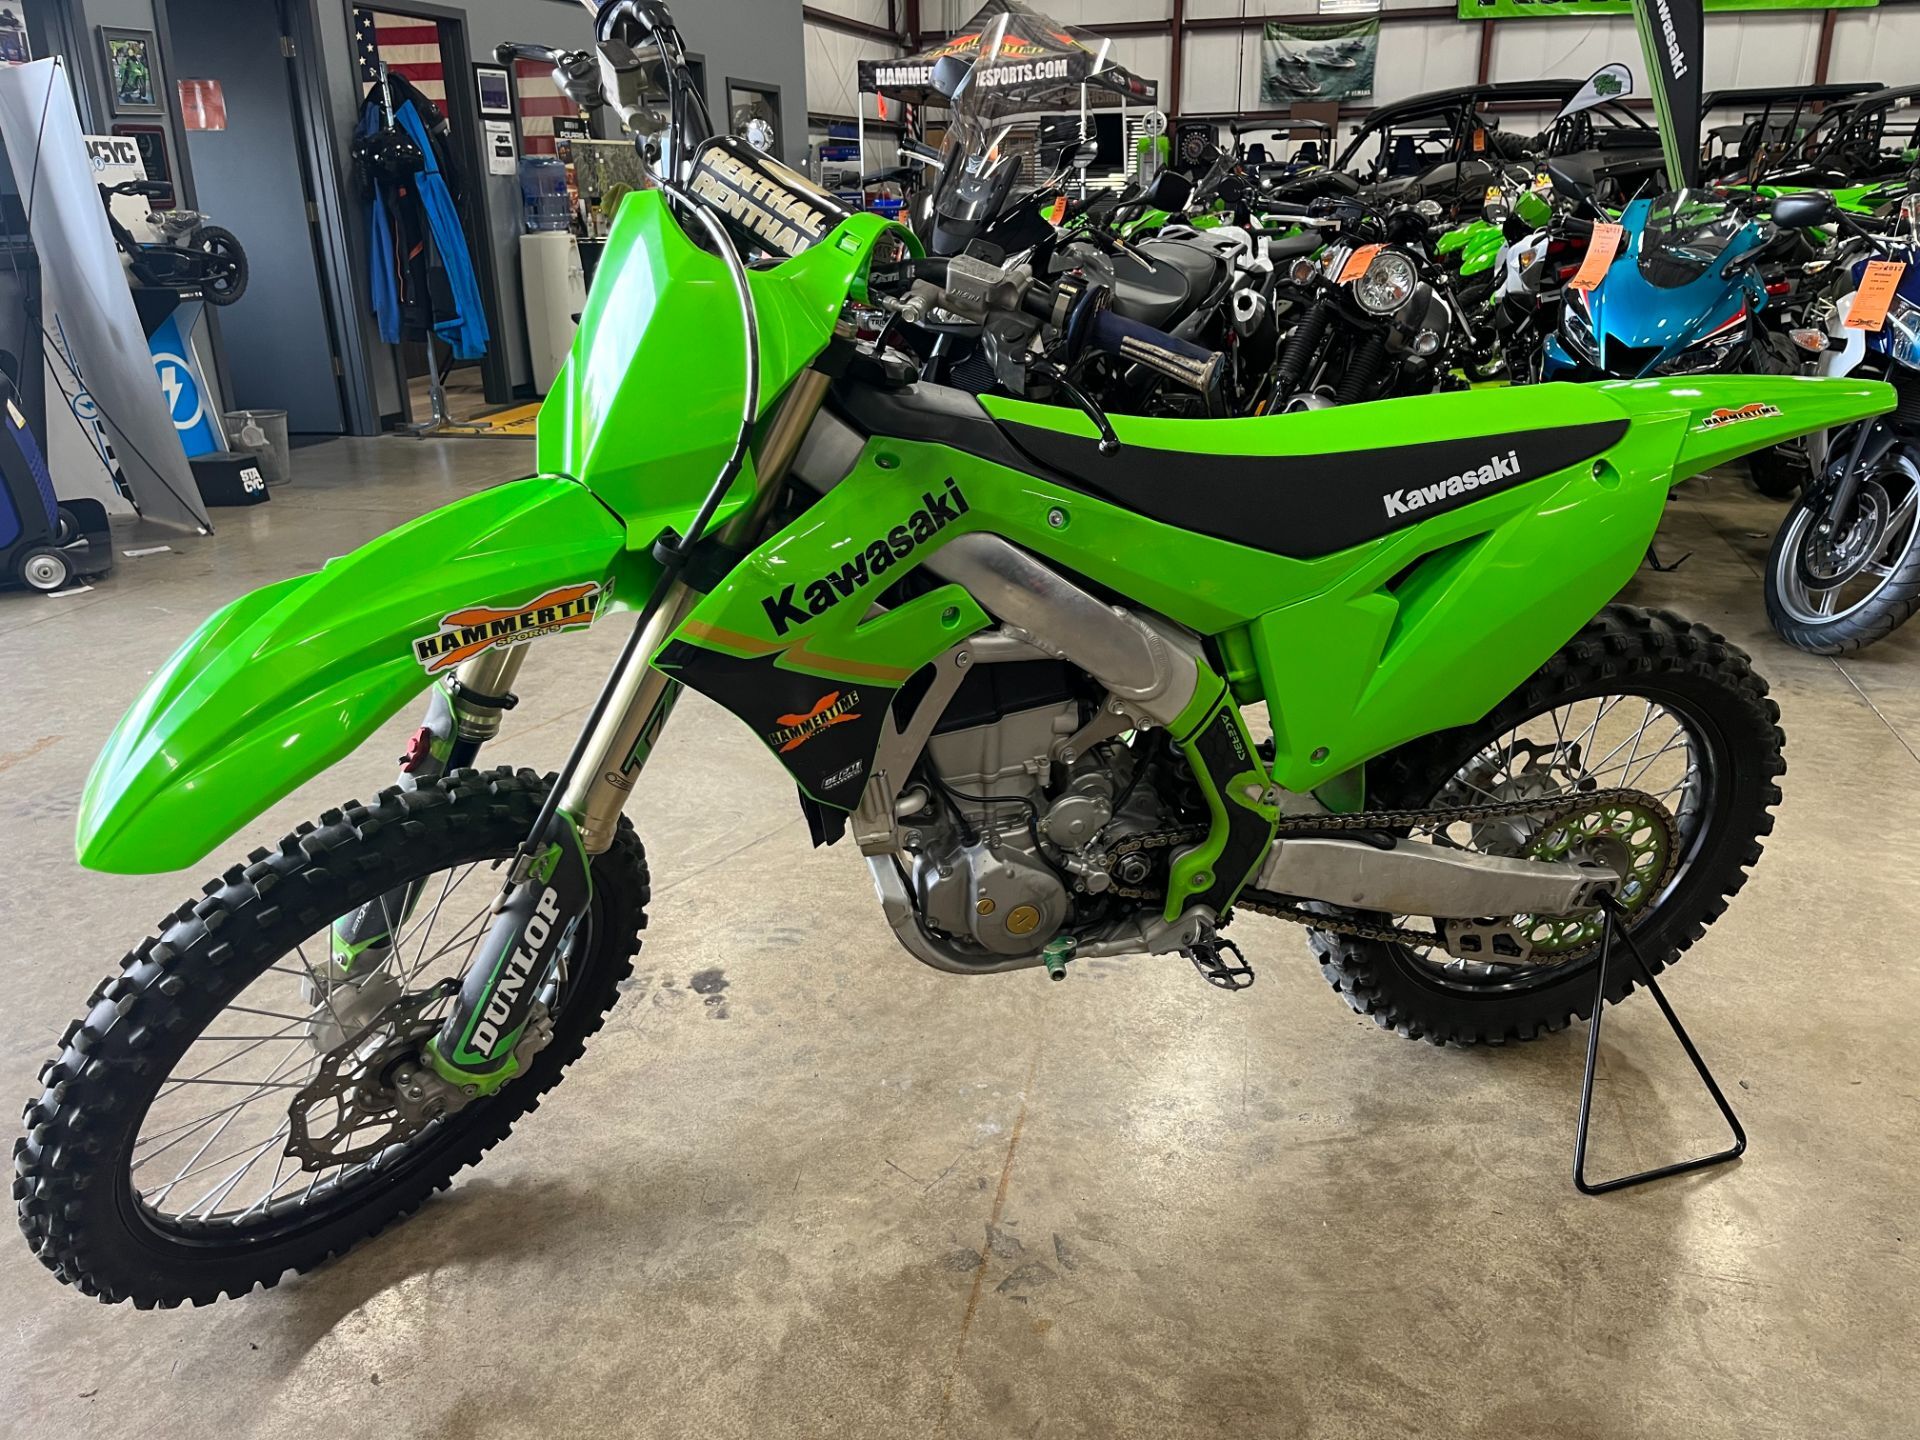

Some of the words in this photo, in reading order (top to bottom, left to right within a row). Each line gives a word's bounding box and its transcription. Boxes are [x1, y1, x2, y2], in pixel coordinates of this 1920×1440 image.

[701, 146, 826, 239] RENTHAL
[240, 467, 261, 482] STA
[244, 478, 265, 493] CYC
[1383, 450, 1521, 518] Kawasaki
[761, 476, 970, 637] Kawasaki
[496, 624, 561, 647] SPORTS
[769, 690, 860, 745] HAMMERTIME
[470, 886, 560, 1056] DUNLOP
